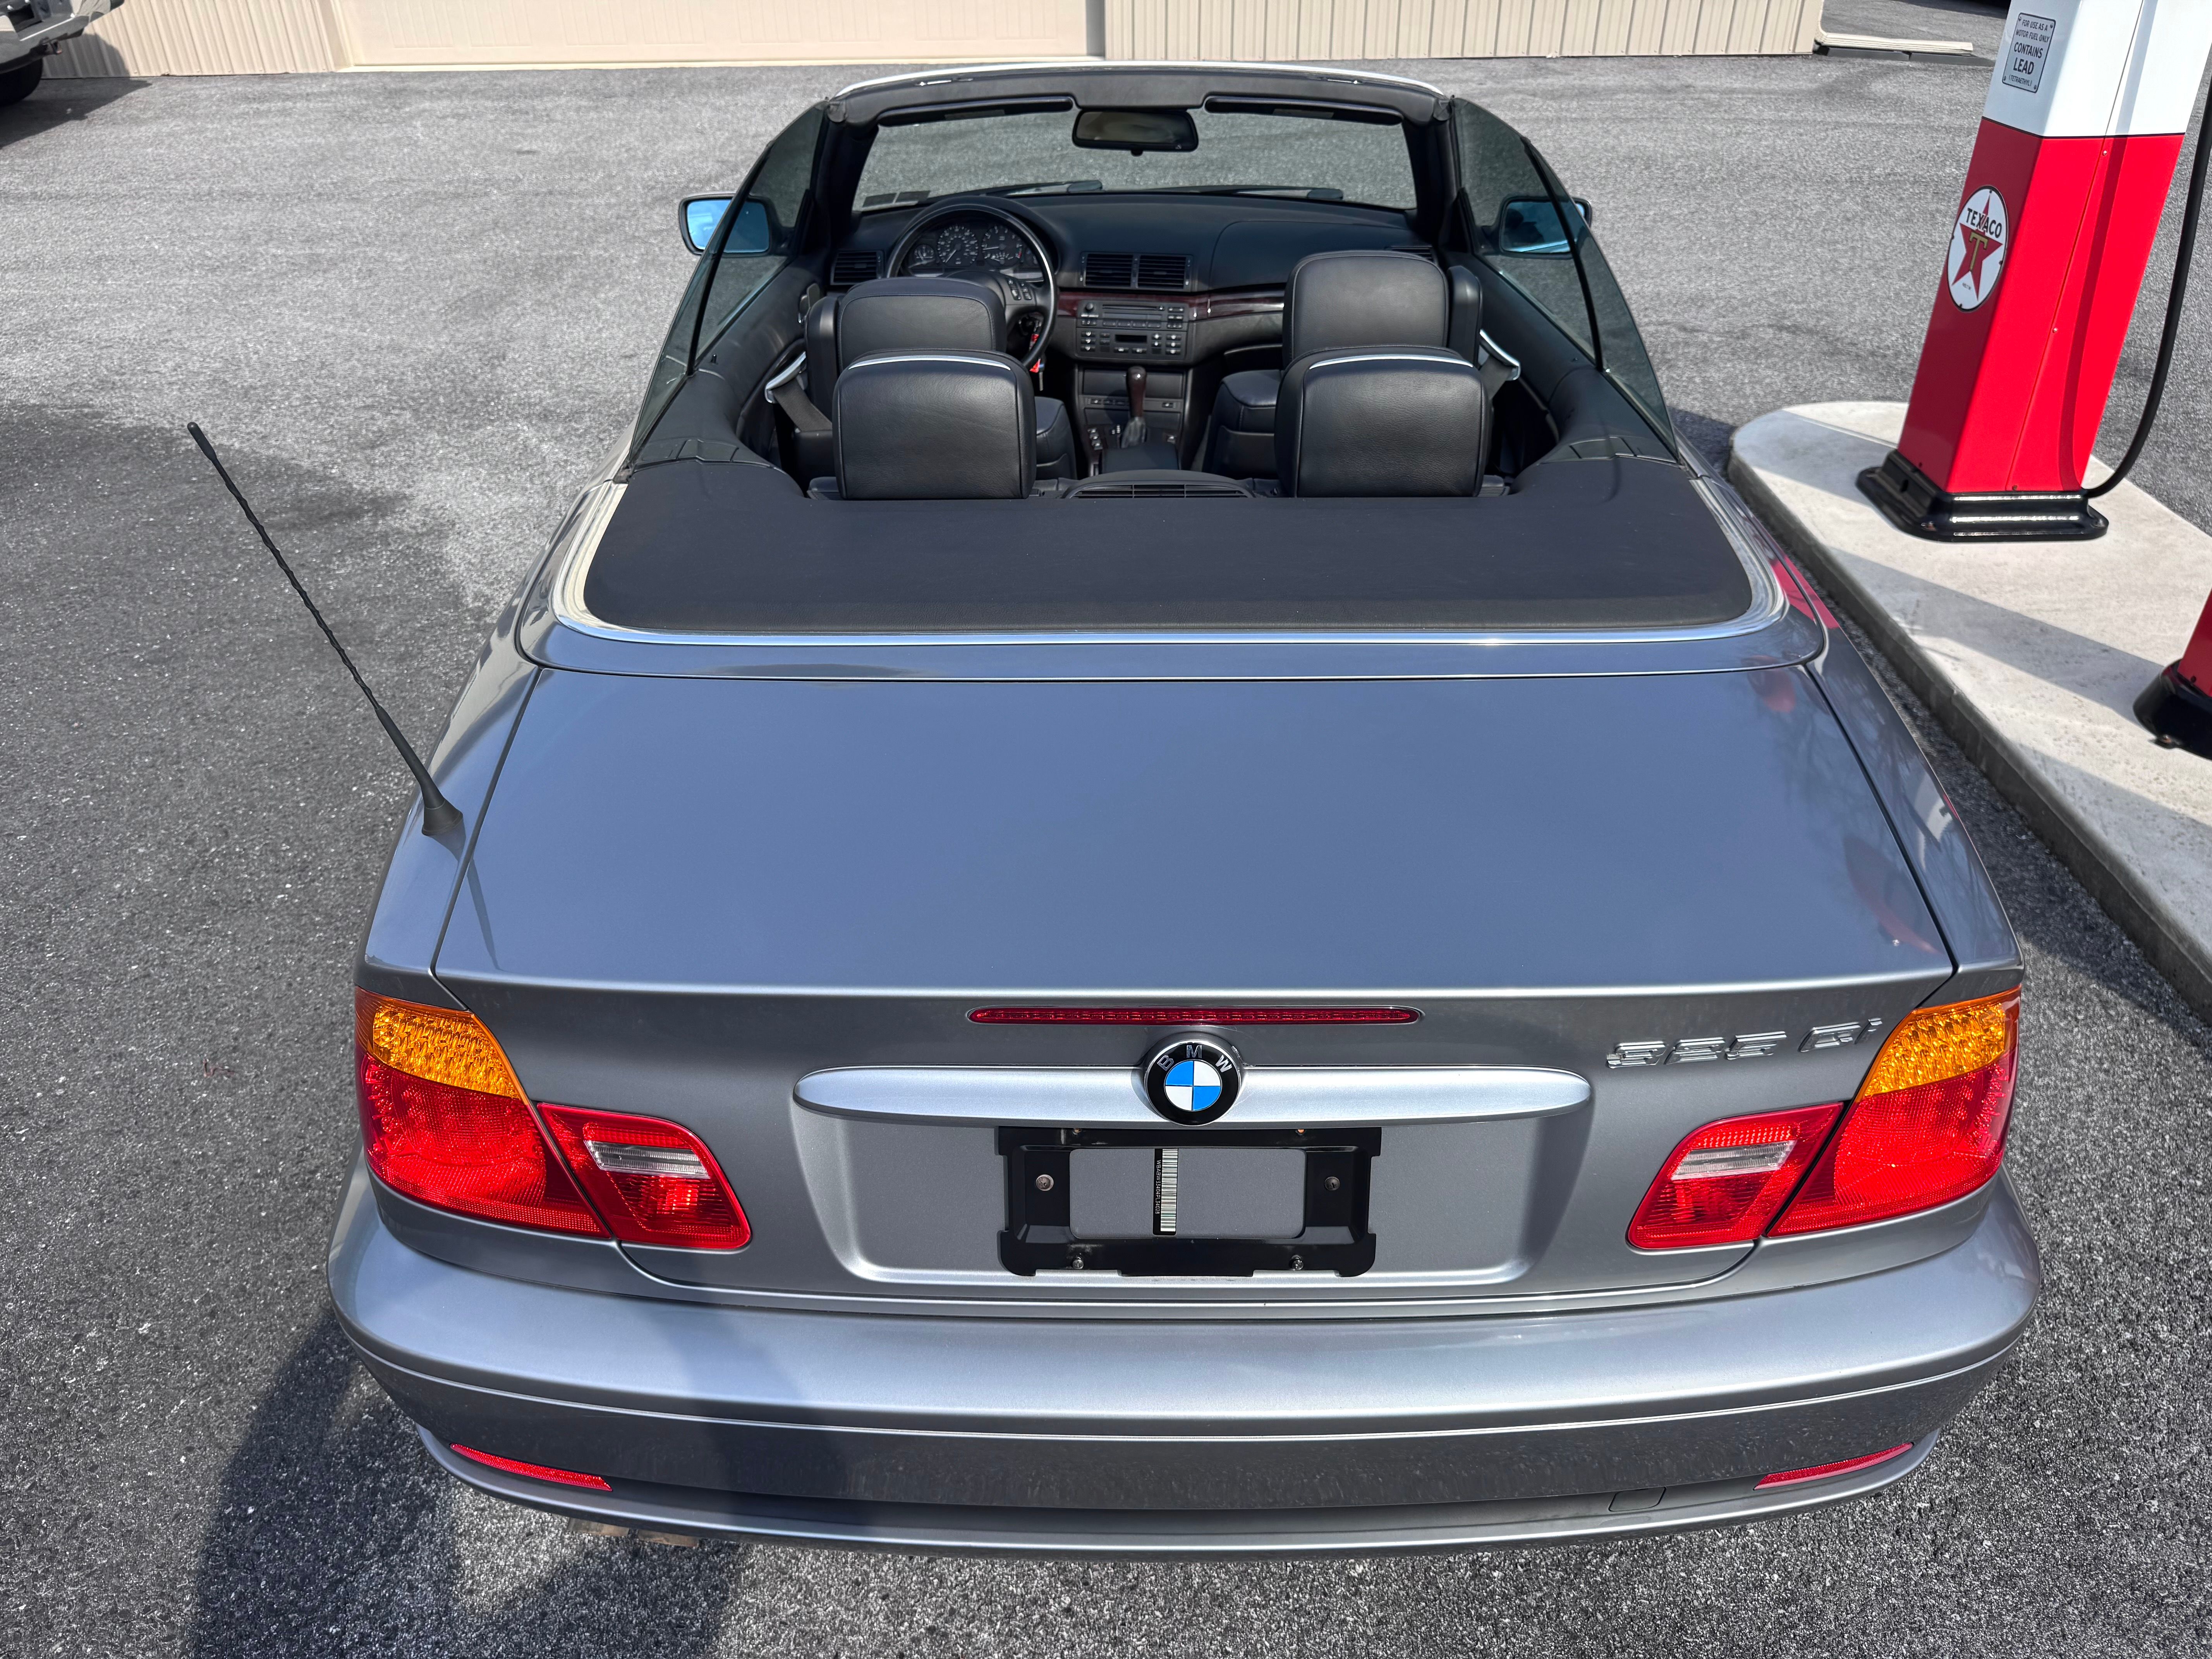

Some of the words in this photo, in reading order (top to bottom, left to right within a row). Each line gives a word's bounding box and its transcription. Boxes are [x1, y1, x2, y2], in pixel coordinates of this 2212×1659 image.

[2038, 23, 2044, 31] AS
[2016, 29, 2028, 38] MOTOR
[2028, 32, 2038, 41] FUEL
[2039, 34, 2050, 43] ONLY
[2014, 42, 2043, 58] CONTAINS
[2013, 57, 2034, 75] LEAD
[2009, 74, 2032, 86] (TETRAETHYL)
[1966, 208, 2002, 239] TEXACO
[1969, 231, 1989, 271] T
[1157, 1045, 1232, 1073] BMW
